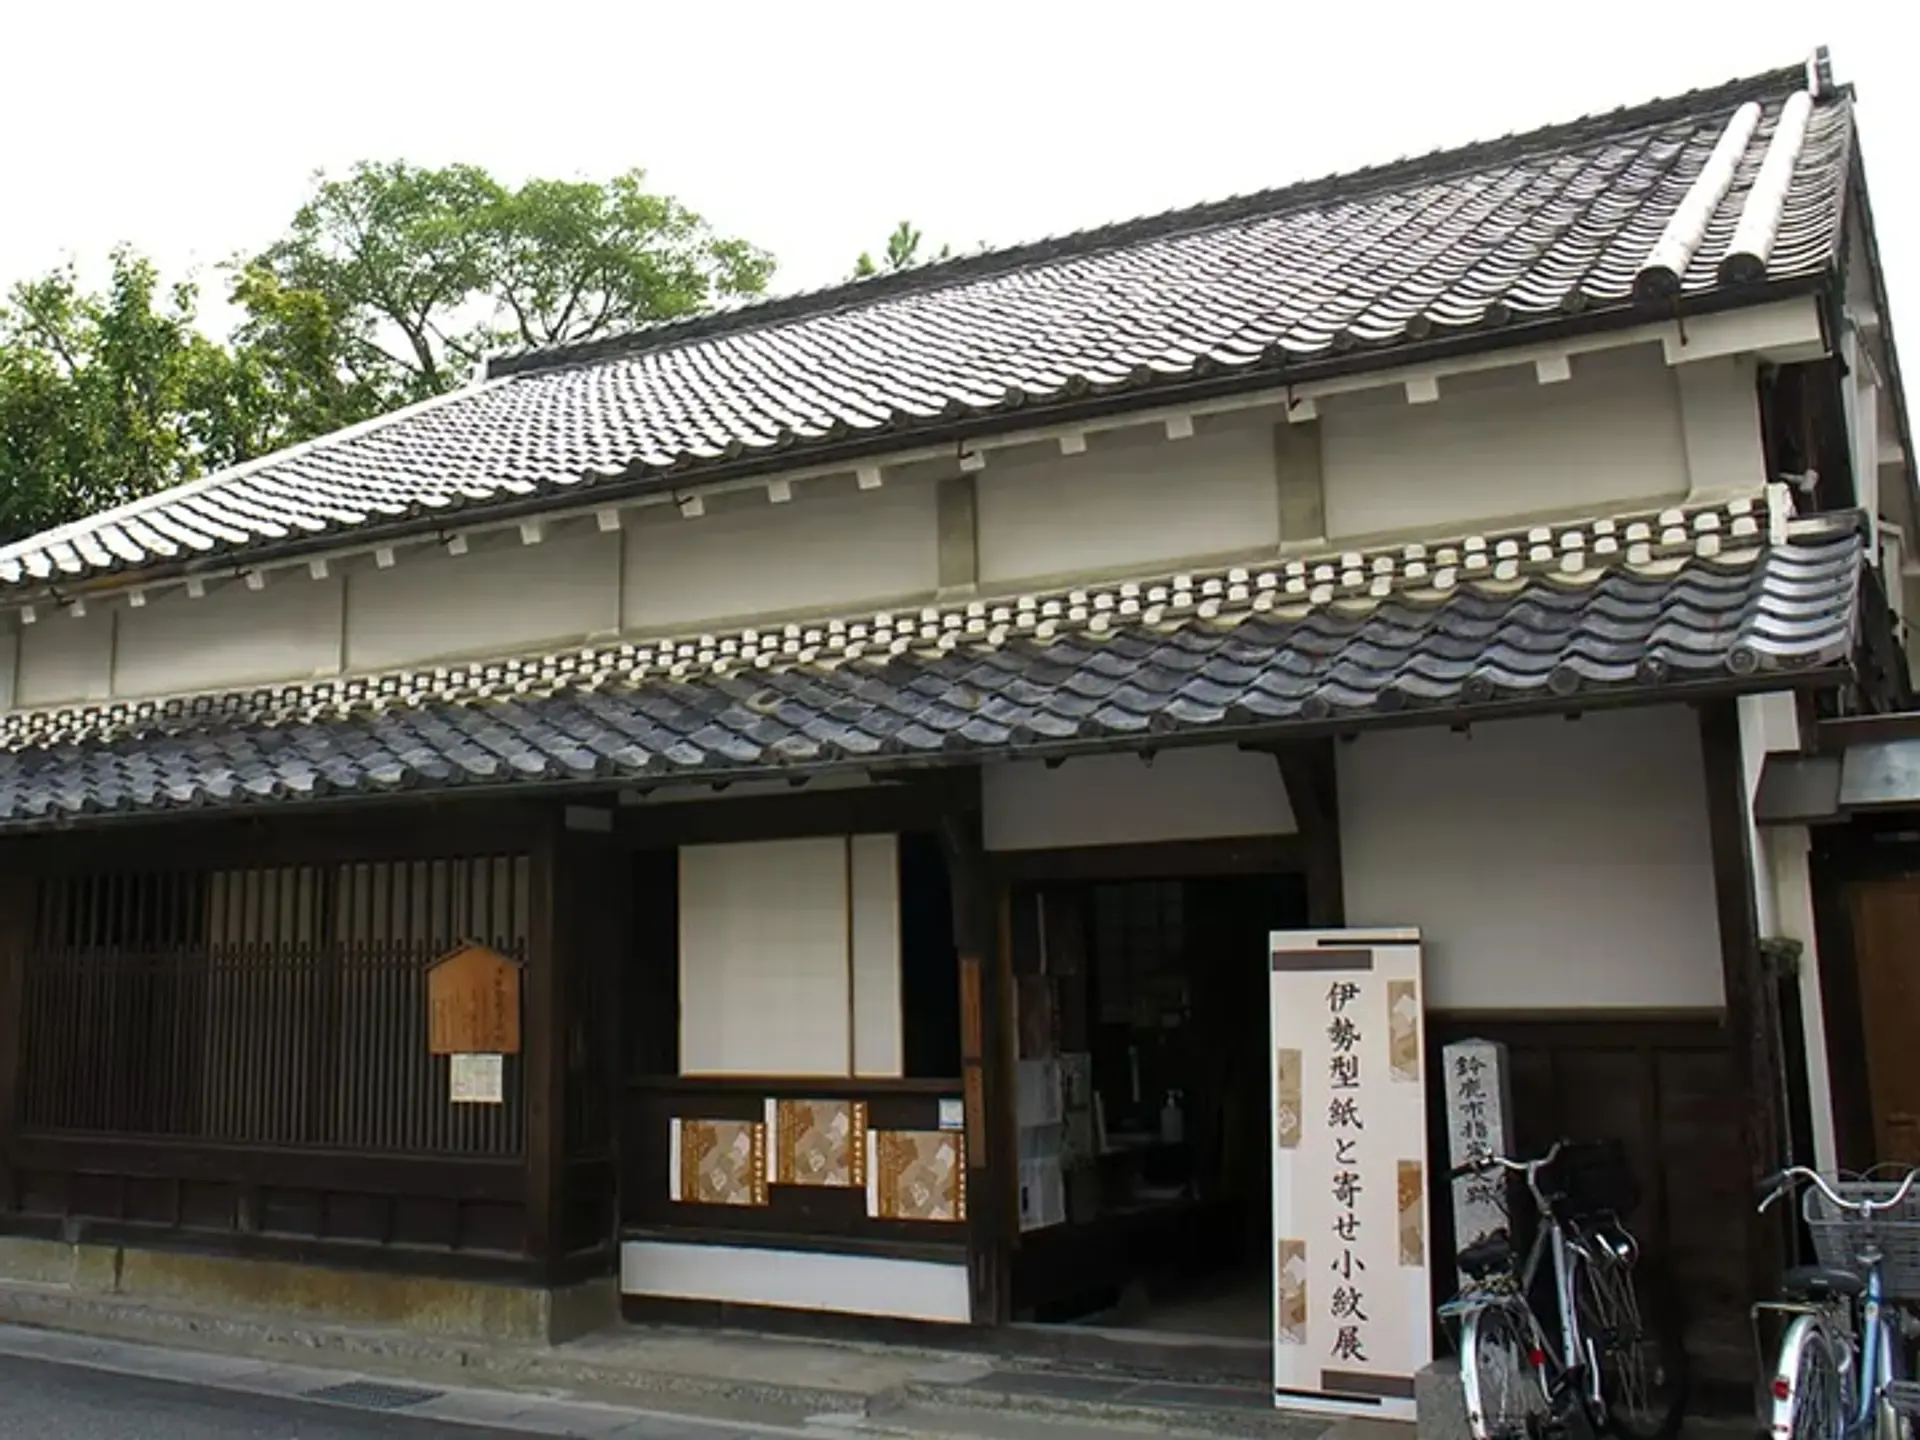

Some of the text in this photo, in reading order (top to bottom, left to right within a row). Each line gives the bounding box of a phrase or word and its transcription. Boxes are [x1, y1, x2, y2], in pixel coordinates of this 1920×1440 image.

[1325, 980, 1369, 1362] 伊勢型紙と寄せ小紋展
